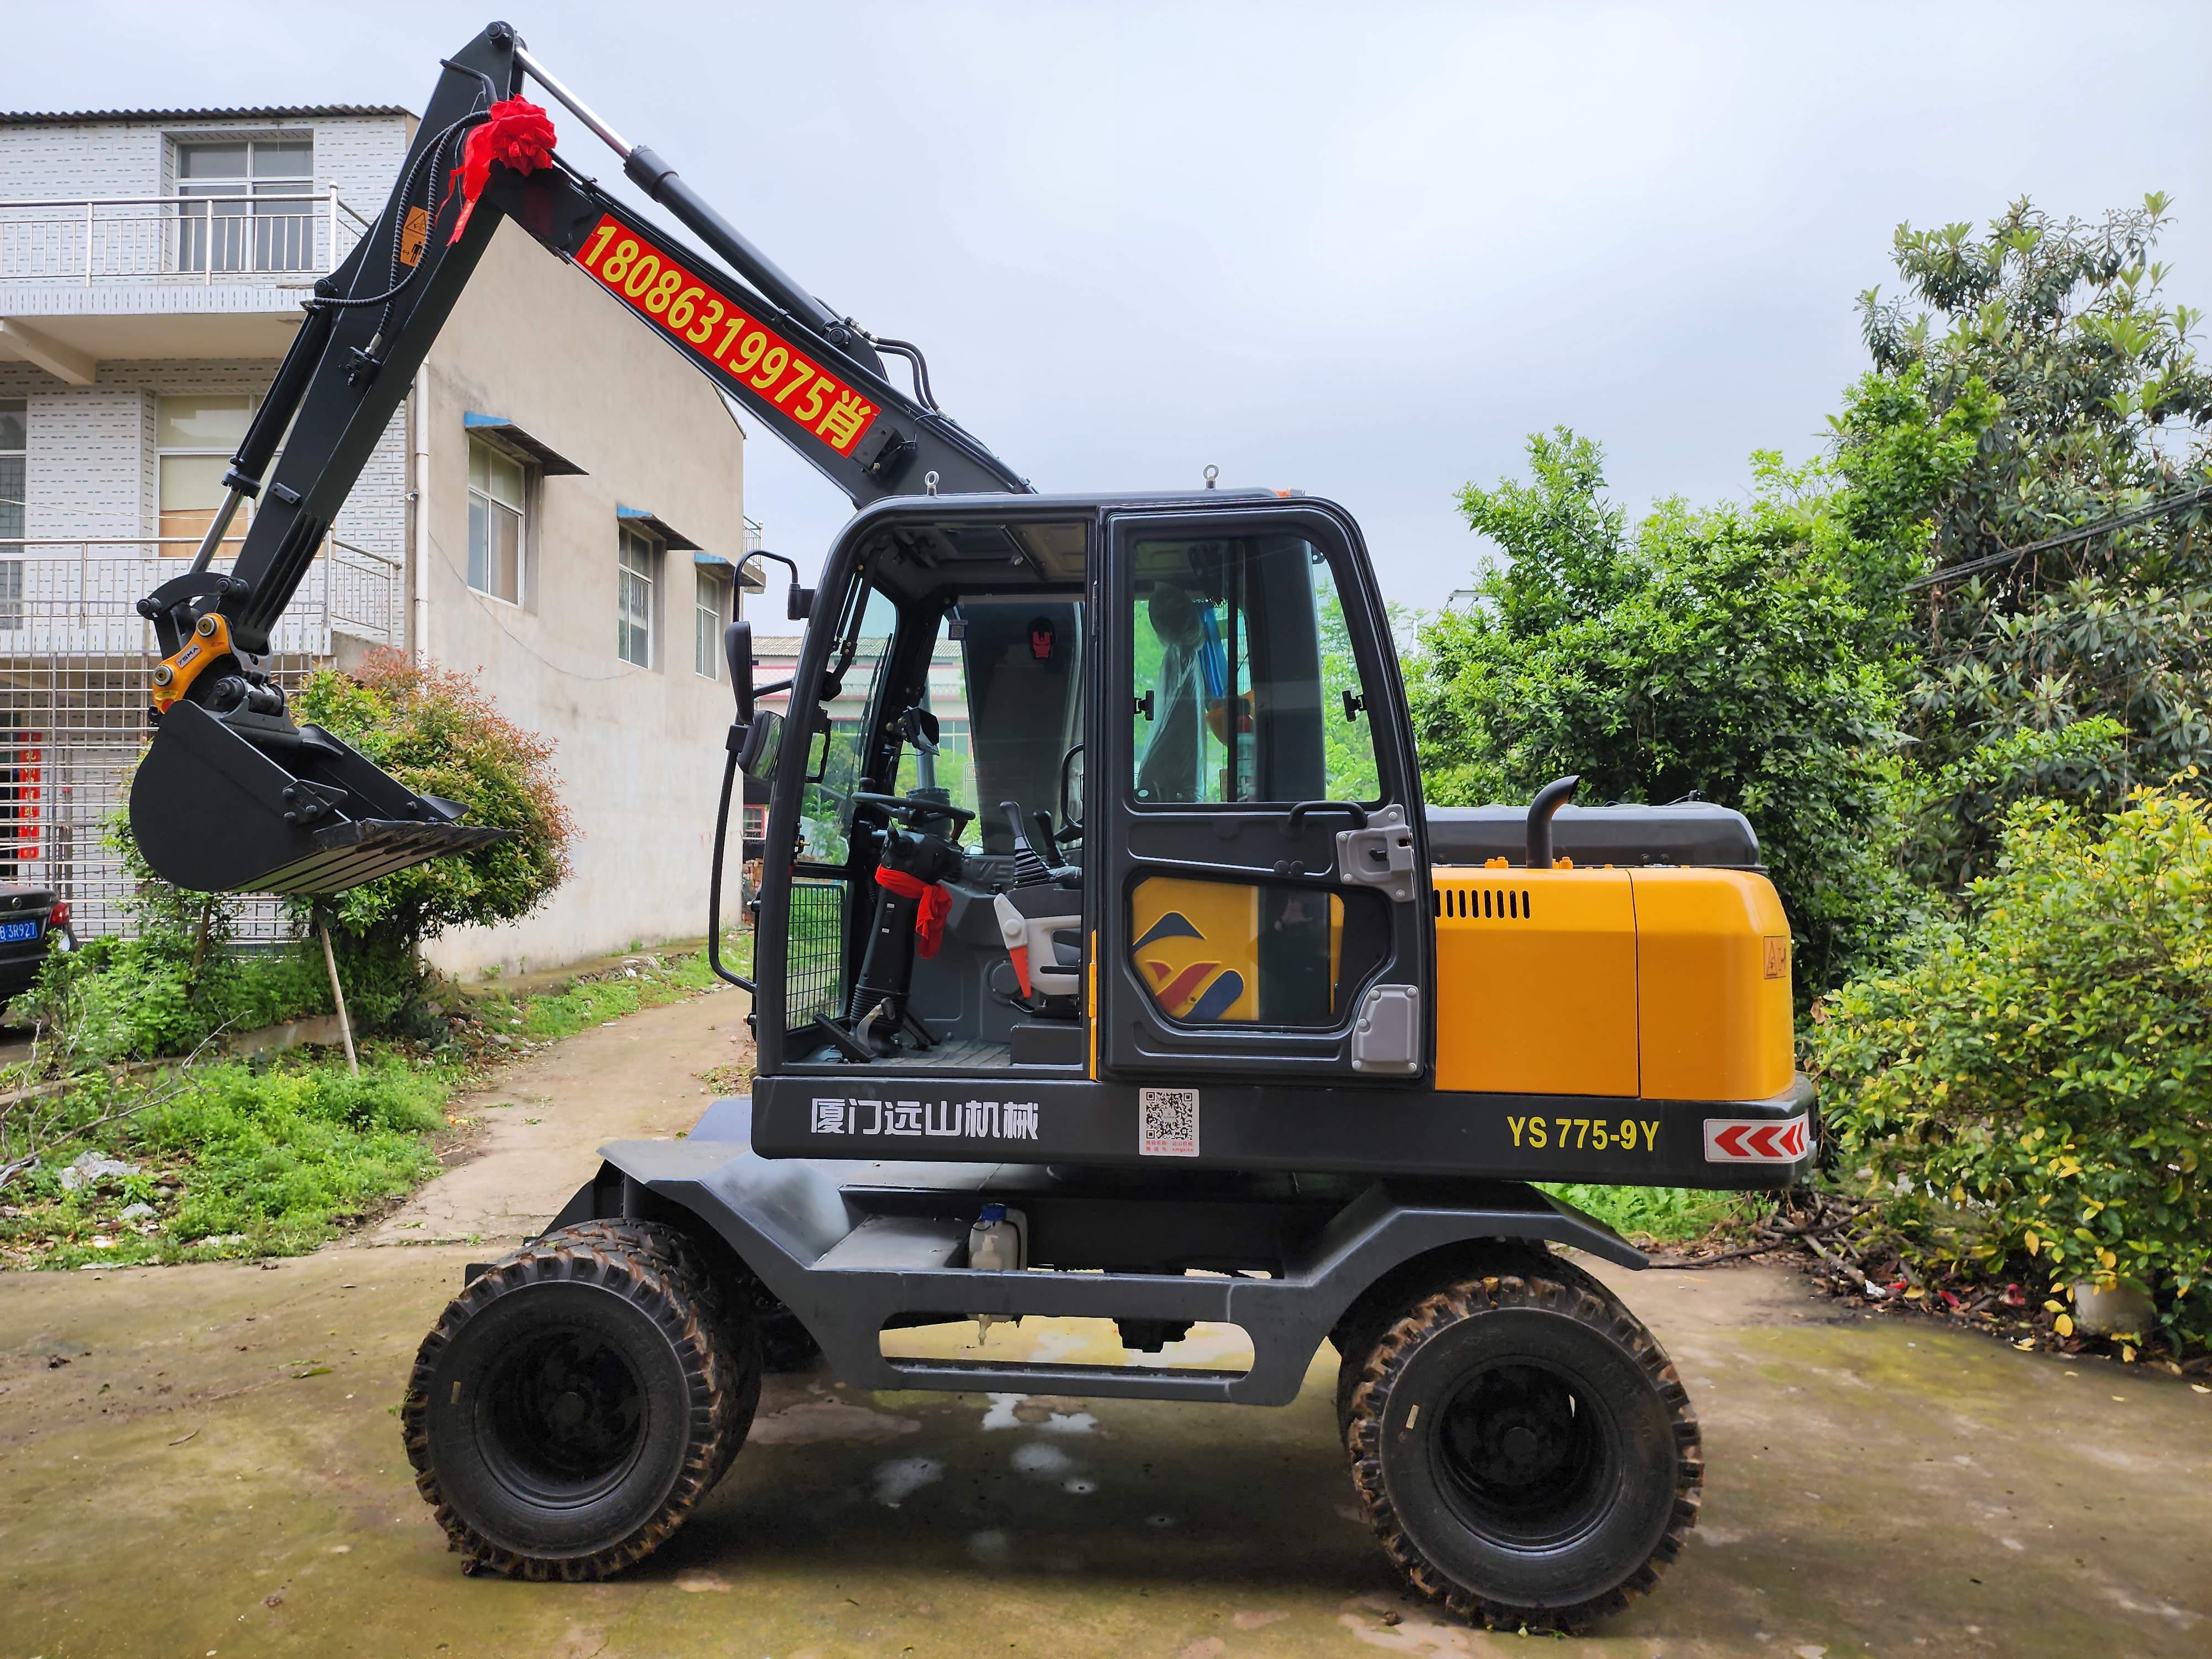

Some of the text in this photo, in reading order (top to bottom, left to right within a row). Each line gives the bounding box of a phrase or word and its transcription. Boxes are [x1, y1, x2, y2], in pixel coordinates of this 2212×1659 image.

[585, 226, 871, 449] 18086319975肖
[811, 1098, 1039, 1140] 厦门远山机械
[1507, 1116, 1660, 1151] YS 775-9Y
